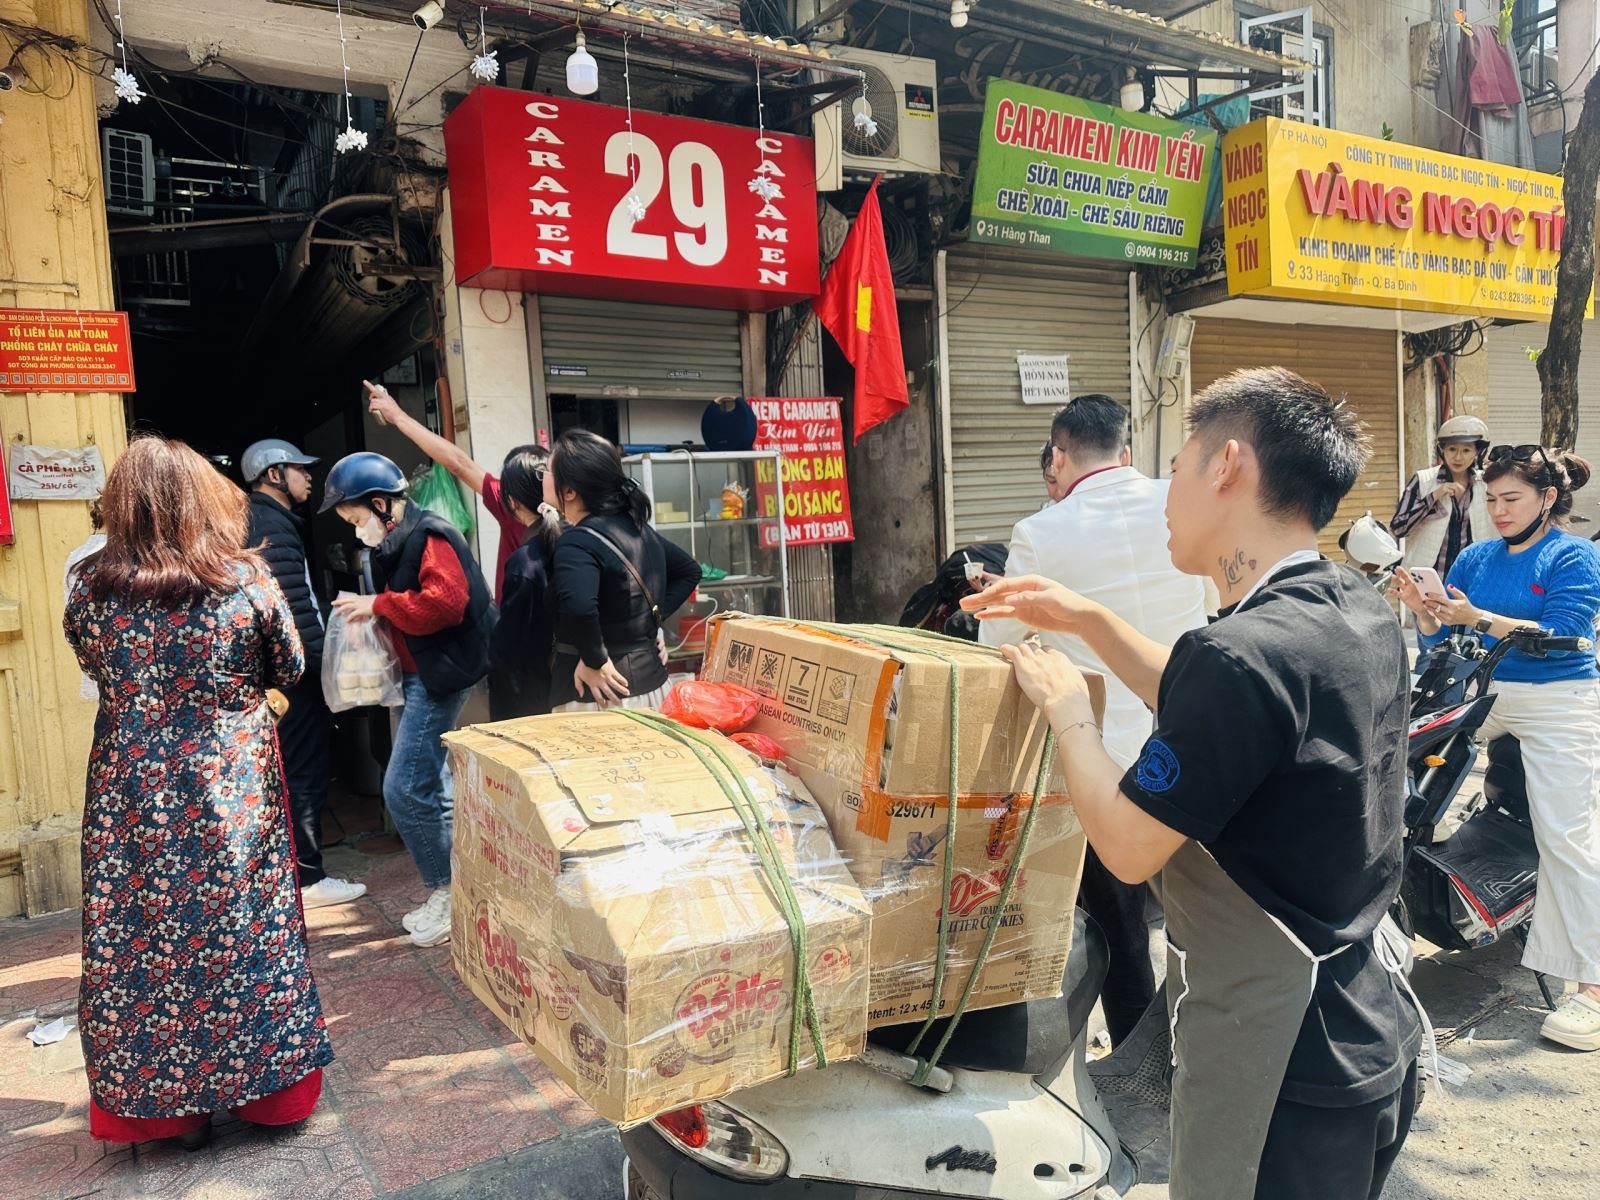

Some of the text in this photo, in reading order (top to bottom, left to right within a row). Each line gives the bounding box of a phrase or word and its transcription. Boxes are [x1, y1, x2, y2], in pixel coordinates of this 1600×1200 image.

[995, 98, 1206, 183] CARAMEN KIM YẾN
[1296, 129, 1310, 144] HÀ
[1311, 135, 1328, 149] NỘI
[1225, 142, 1263, 184] VÀNG
[1346, 144, 1372, 164] CÔNG
[1375, 151, 1387, 167] TY
[1388, 154, 1413, 171] TNHH
[1415, 158, 1439, 177] VÀNG
[1441, 165, 1459, 183] BẠC
[1460, 169, 1484, 188] NGỌC
[1486, 172, 1499, 188] TÍN
[1506, 177, 1528, 196] NGỌC
[1530, 181, 1543, 197] TÍN
[524, 102, 574, 267] CARAMEN
[1062, 169, 1101, 196] CHUA
[1104, 172, 1135, 201] NẾP
[1137, 178, 1169, 207] CẨM
[604, 131, 728, 267] 29
[997, 186, 1029, 215] CHÈ
[1031, 193, 1070, 220] XOÀI
[1081, 201, 1110, 227] CHÈ
[1112, 204, 1140, 231] SẦU
[1142, 210, 1185, 238] RIÊNG
[1227, 187, 1266, 229] NGỌC
[1297, 161, 1414, 231] VÀNG
[1423, 190, 1526, 253] NGỌC
[987, 224, 1051, 245] 31 Hàng Than
[1136, 245, 1189, 262] 0904 196 215
[1235, 234, 1259, 273] TÍN
[1299, 236, 1328, 259] KINH
[1332, 240, 1371, 264] DOANH
[1374, 243, 1396, 267] CHẾ
[1398, 248, 1419, 270] TÁC
[1422, 250, 1449, 273] VÀNG
[1452, 258, 1471, 279] BẠC
[1474, 257, 1486, 278] ĐÁ
[1299, 265, 1313, 281] 33
[1315, 270, 1340, 286] Hàng
[1342, 272, 1364, 287] Than
[1372, 276, 1382, 289] Q.
[1384, 278, 1396, 289] Ba
[1398, 279, 1417, 292] Đình
[8, 325, 108, 339] TỔ LIÊN GIA AN TOÀN
[38, 341, 62, 352] CHÁY
[65, 341, 92, 352] CHỮA
[94, 342, 118, 352] CHÁY
[783, 401, 838, 421] CARAMEN
[759, 422, 836, 441] Kim Yến
[18, 461, 34, 473] CÀ
[36, 462, 61, 473] PHÊ
[813, 454, 844, 480] BÁN
[803, 489, 843, 516] SÁNG
[804, 520, 821, 538] TỪ
[822, 520, 849, 538] 13H)
[1218, 547, 1246, 593] Love
[800, 665, 810, 686] 7
[759, 704, 781, 720] ASEAN
[782, 712, 822, 735] COUNTRIES
[899, 1002, 910, 1015] 12
[911, 1004, 918, 1012] x
